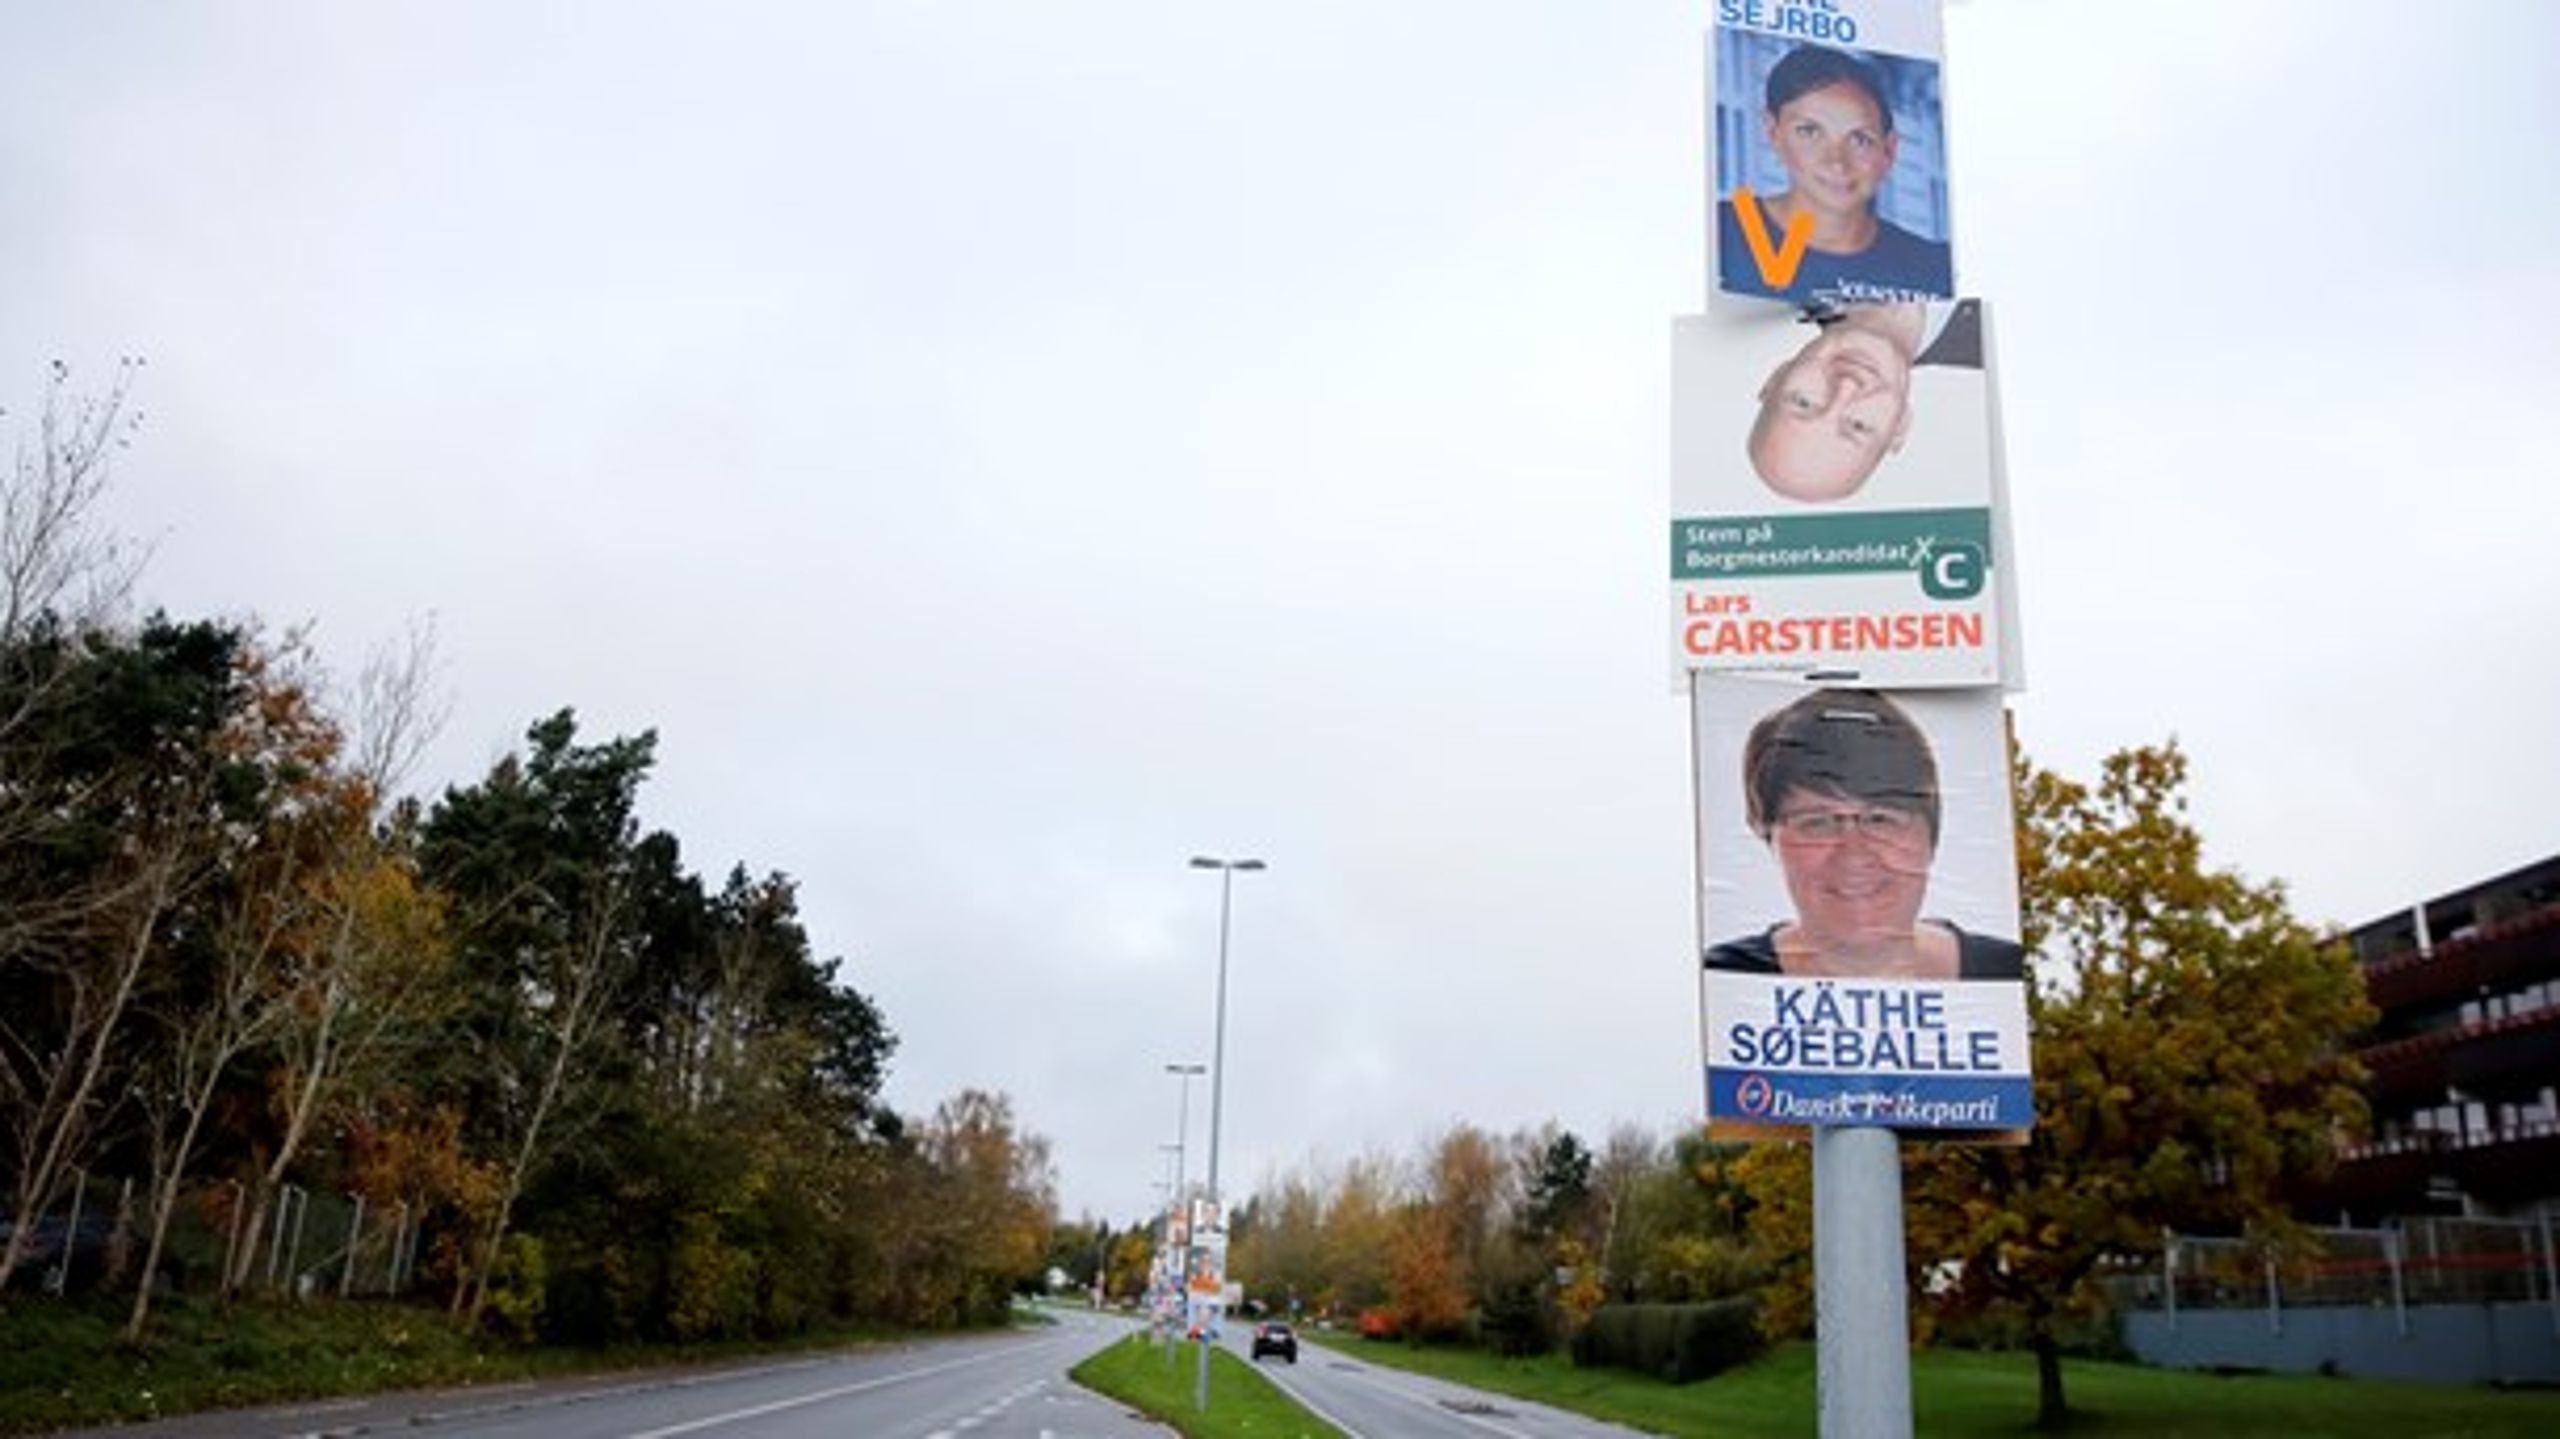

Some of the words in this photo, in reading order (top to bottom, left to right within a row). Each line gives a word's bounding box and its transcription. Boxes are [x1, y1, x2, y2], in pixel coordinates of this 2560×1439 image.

[1719, 0, 1857, 43] SEJRBO
[1732, 186, 1816, 289] V
[1685, 525, 1742, 543] Stem
[1746, 523, 1773, 543] på
[1685, 543, 1910, 572] Borgmesterkandidat
[1934, 552, 1969, 590] C
[1685, 591, 1751, 614] Lars
[1684, 612, 1984, 656] CARSTENSEN
[1774, 980, 1947, 1029] KÄTHE
[1729, 1023, 2003, 1071] SØEBALLE
